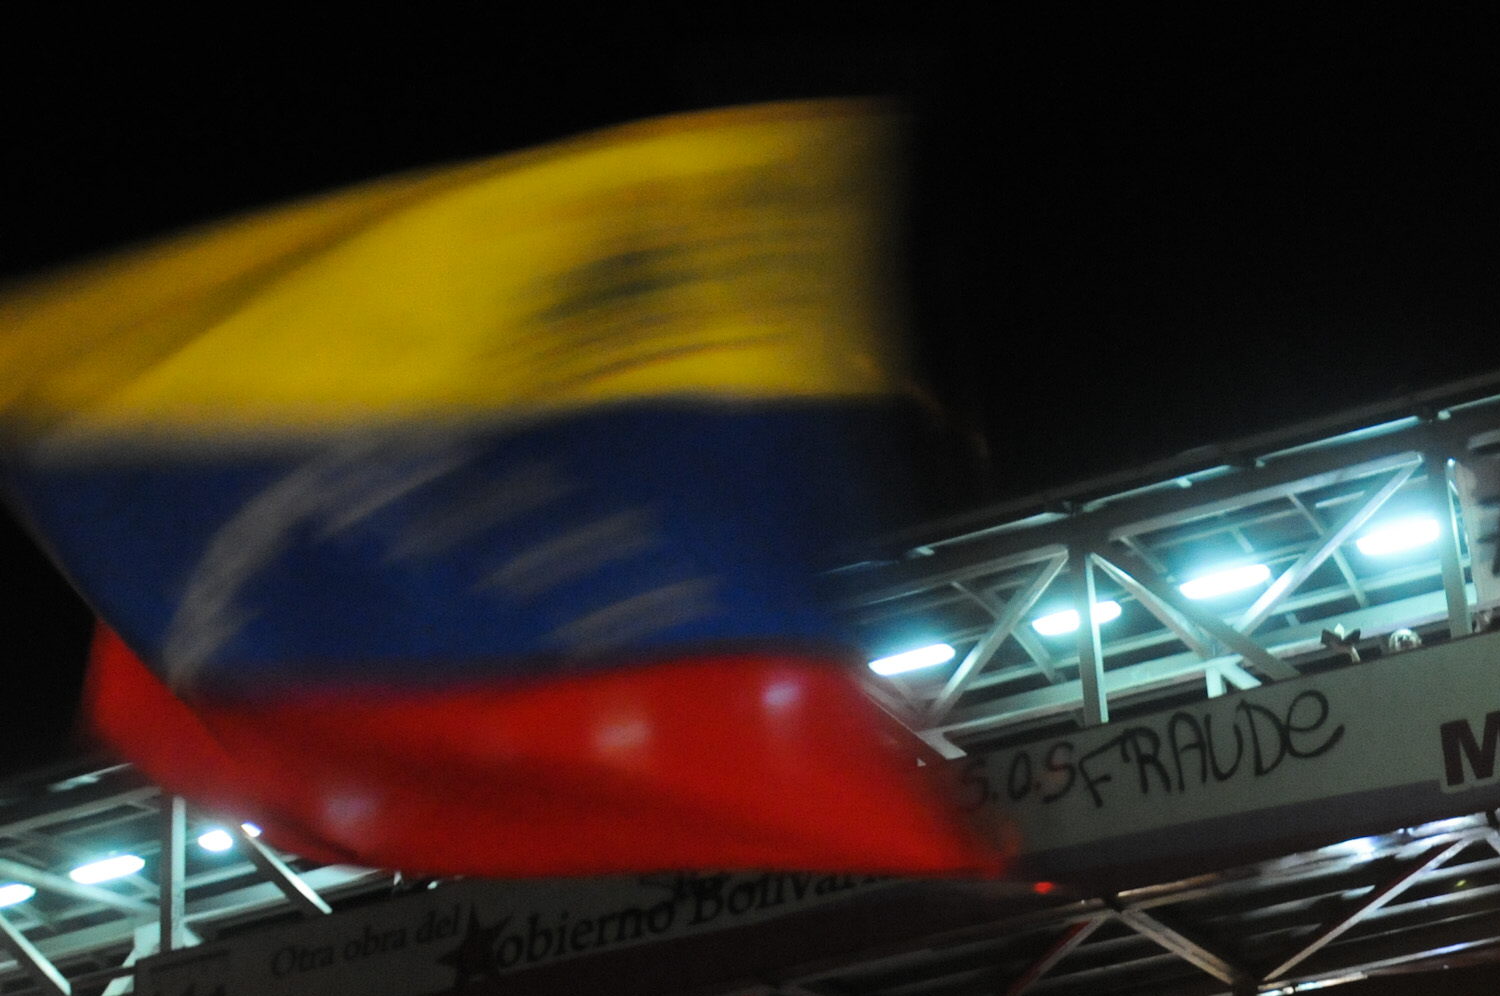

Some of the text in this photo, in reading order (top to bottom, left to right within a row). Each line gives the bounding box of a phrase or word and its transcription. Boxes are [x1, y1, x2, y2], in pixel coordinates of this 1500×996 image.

[270, 941, 336, 978] Otra
[343, 924, 407, 962] obra
[415, 902, 461, 944] del
